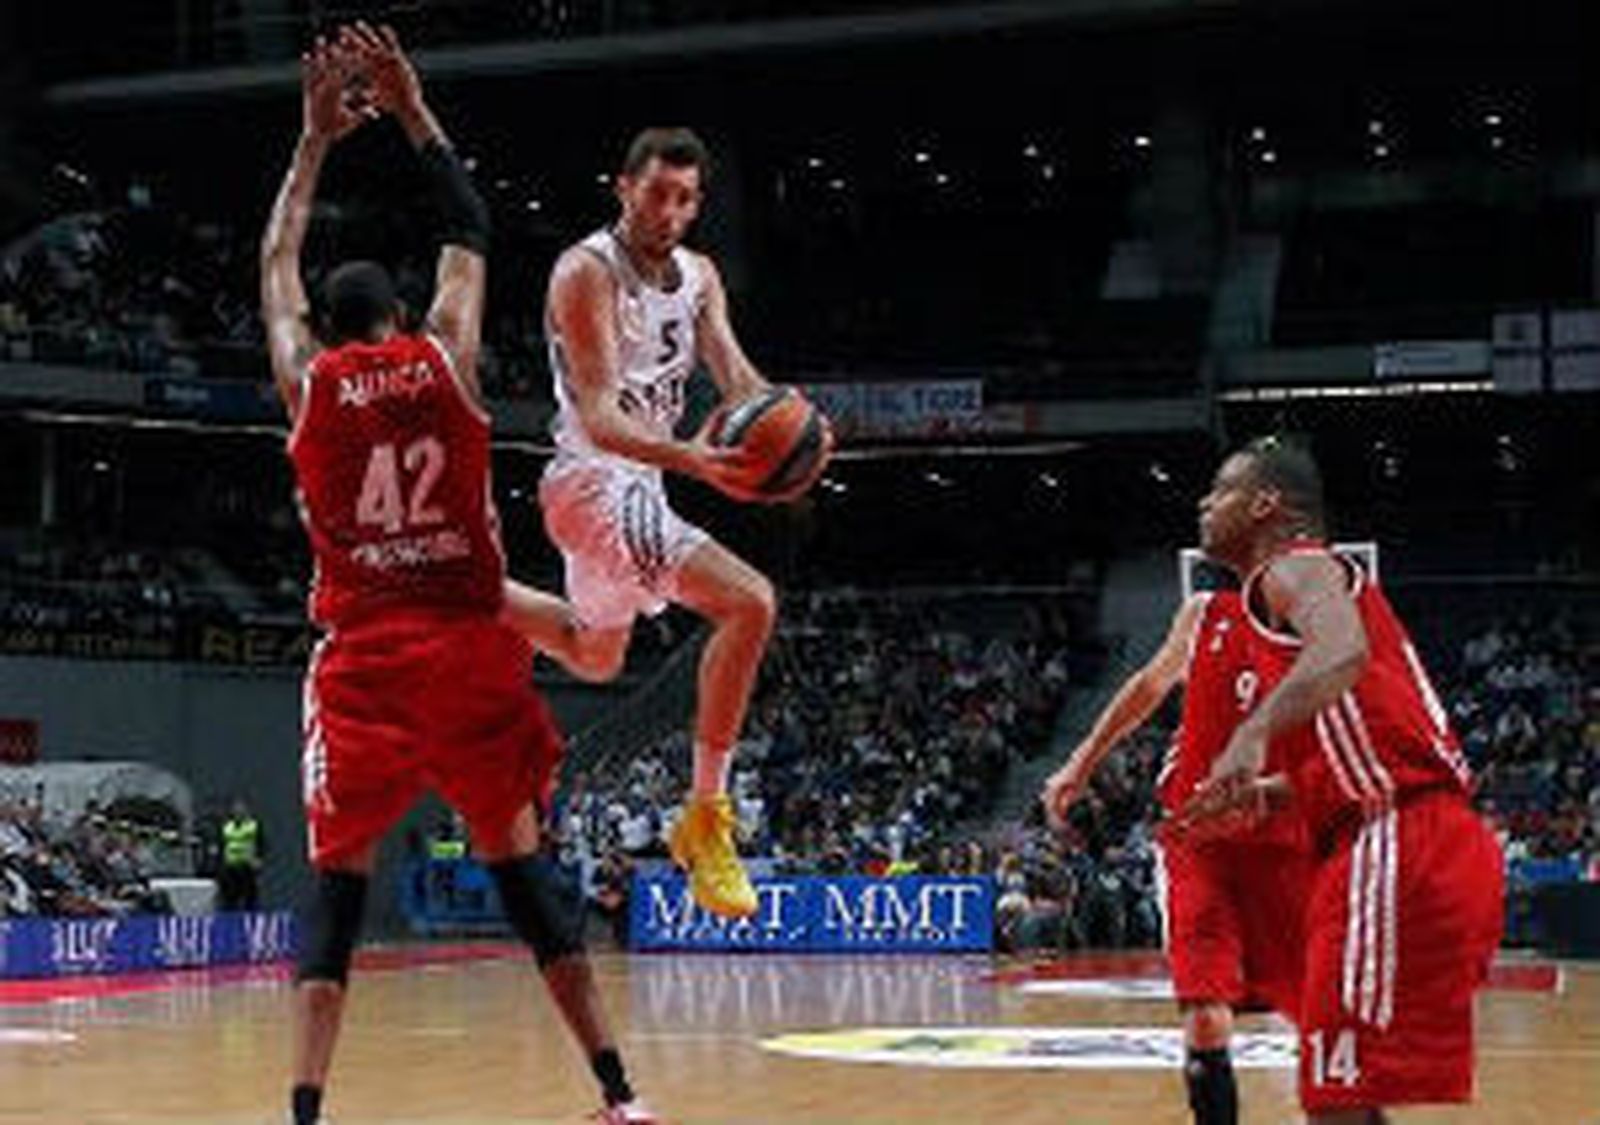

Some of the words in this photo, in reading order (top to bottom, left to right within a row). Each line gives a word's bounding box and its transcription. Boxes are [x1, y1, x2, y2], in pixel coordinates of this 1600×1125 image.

[657, 319, 679, 365] 5
[356, 436, 446, 532] 42
[1235, 670, 1259, 712] 9
[823, 884, 982, 929] MMT
[1308, 1029, 1360, 1087] 14
